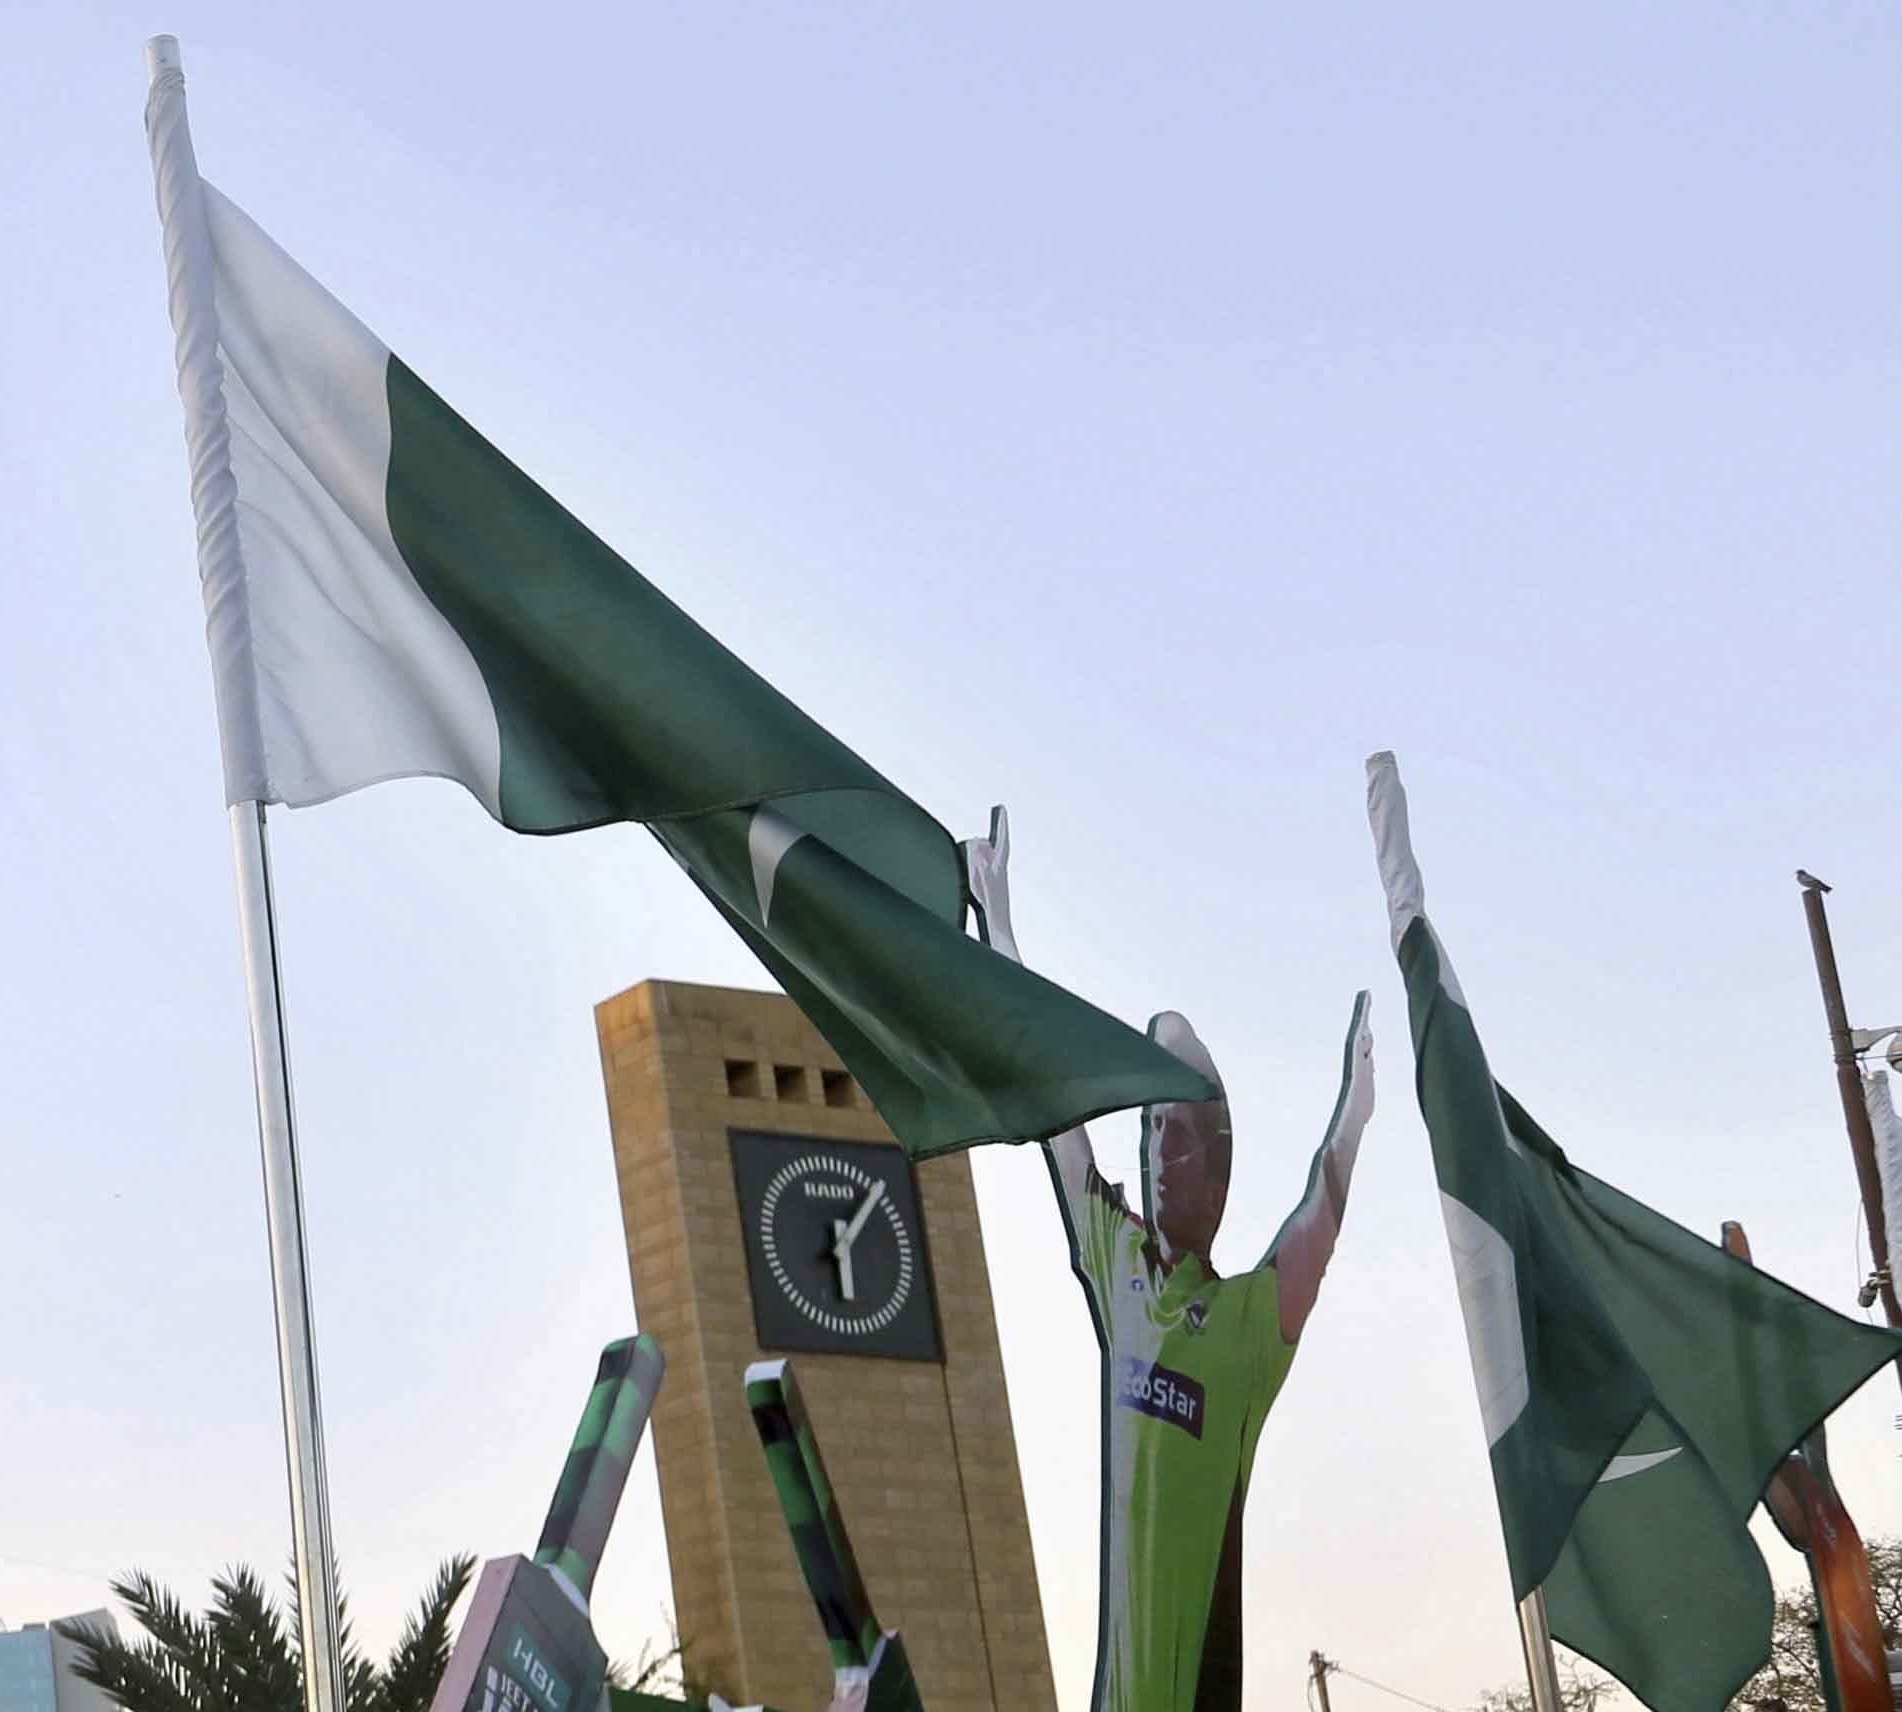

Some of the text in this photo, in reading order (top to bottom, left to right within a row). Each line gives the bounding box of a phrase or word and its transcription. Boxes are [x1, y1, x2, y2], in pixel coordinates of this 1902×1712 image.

[804, 1181, 854, 1200] RADO
[499, 1672, 532, 1712] JEET
[512, 1637, 560, 1710] HBL
